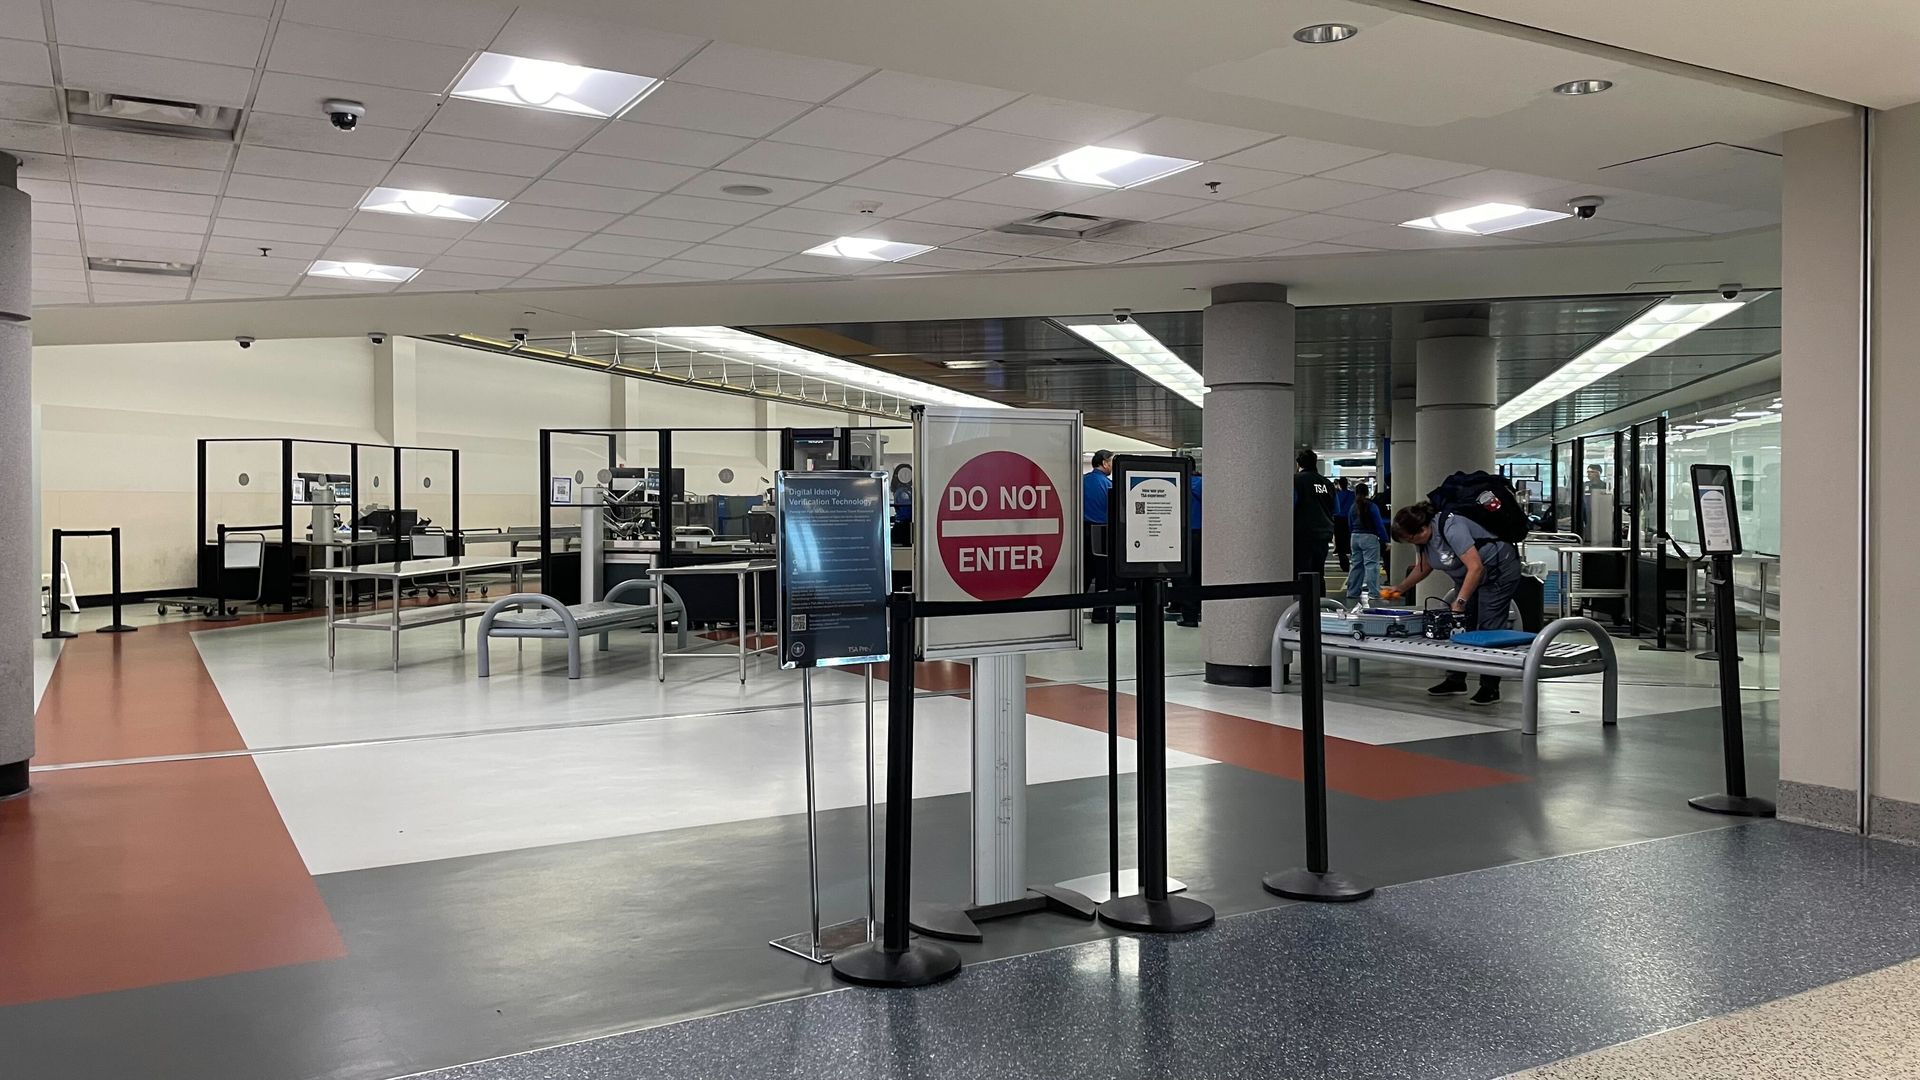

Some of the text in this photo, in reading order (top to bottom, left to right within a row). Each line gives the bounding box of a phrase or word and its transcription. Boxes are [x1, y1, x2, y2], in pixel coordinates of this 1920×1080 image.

[789, 488, 841, 497] Digital Identity
[1314, 484, 1328, 493] TSA
[789, 498, 872, 507] Verification Technology
[950, 485, 1051, 511] DO NOT
[959, 546, 1043, 572] ENTER
